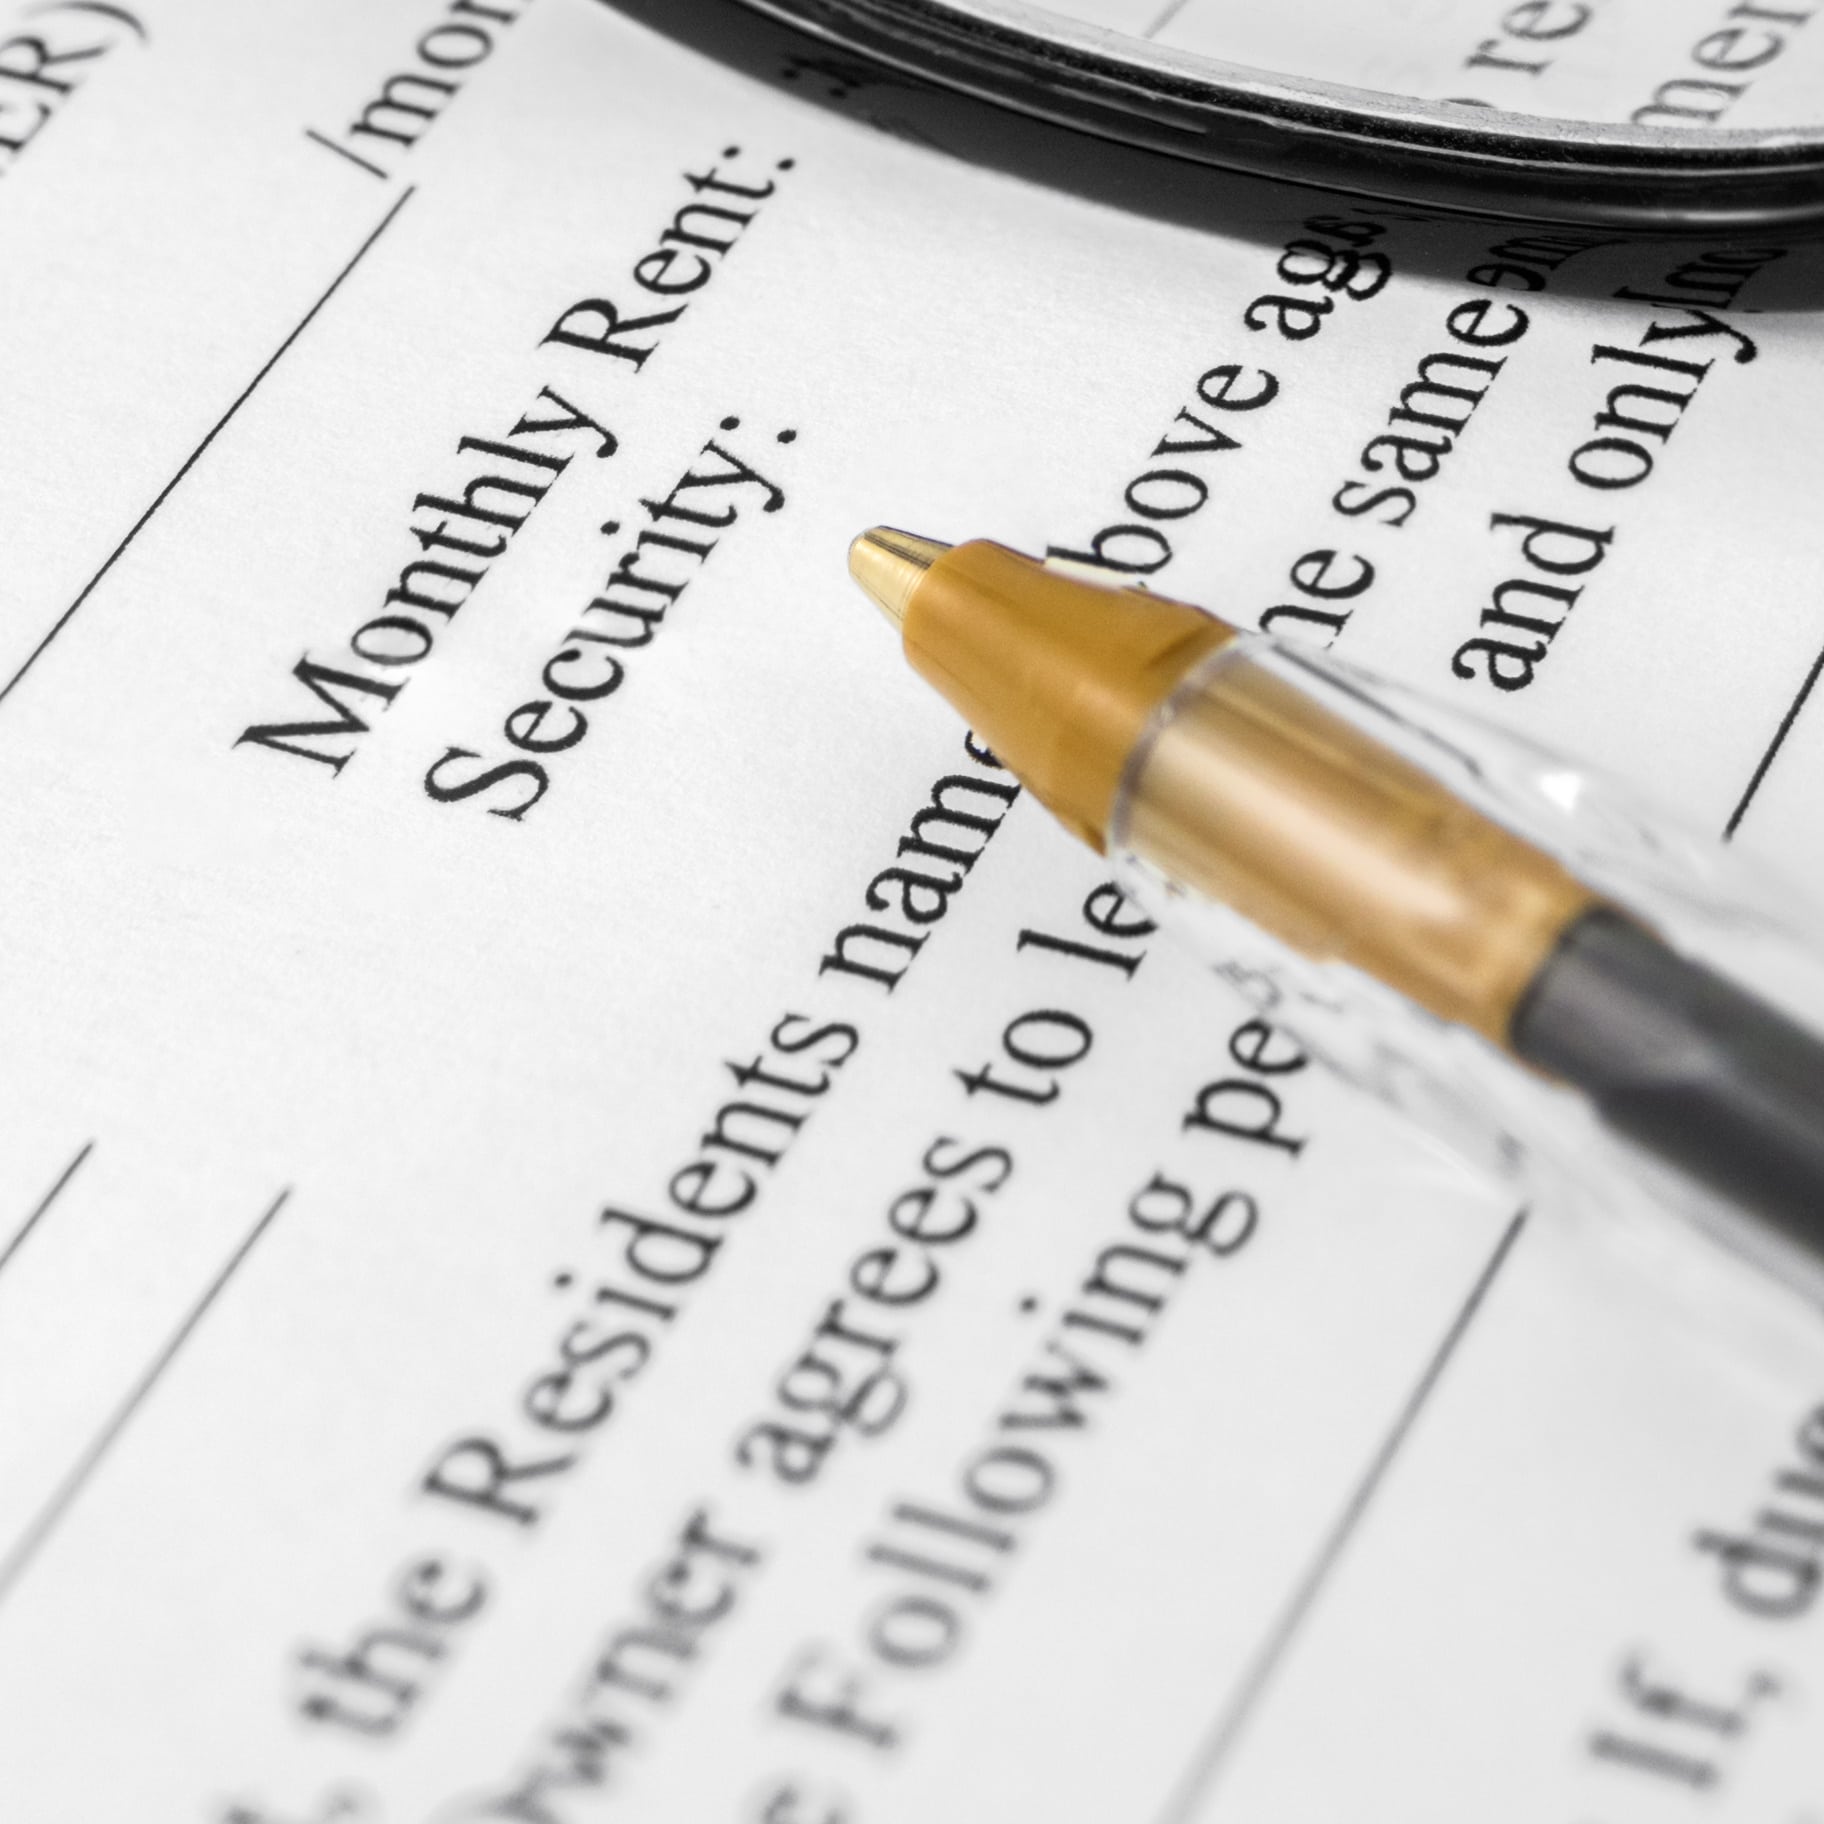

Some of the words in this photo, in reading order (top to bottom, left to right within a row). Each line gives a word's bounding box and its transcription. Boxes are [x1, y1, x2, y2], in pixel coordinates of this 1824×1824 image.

[233, 387, 617, 778] Monthly
[540, 145, 795, 373] Rent:
[296, 1556, 488, 1737] the
[424, 1013, 860, 1527] Residents
[1044, 359, 1279, 575] bove
[424, 416, 796, 821] Security:
[735, 1135, 1017, 1485] agrees
[953, 1006, 1093, 1108] to
[1332, 298, 1529, 527] same
[774, 1173, 1260, 1748] Following
[1450, 512, 1615, 691] and
[1569, 306, 1757, 489] only
